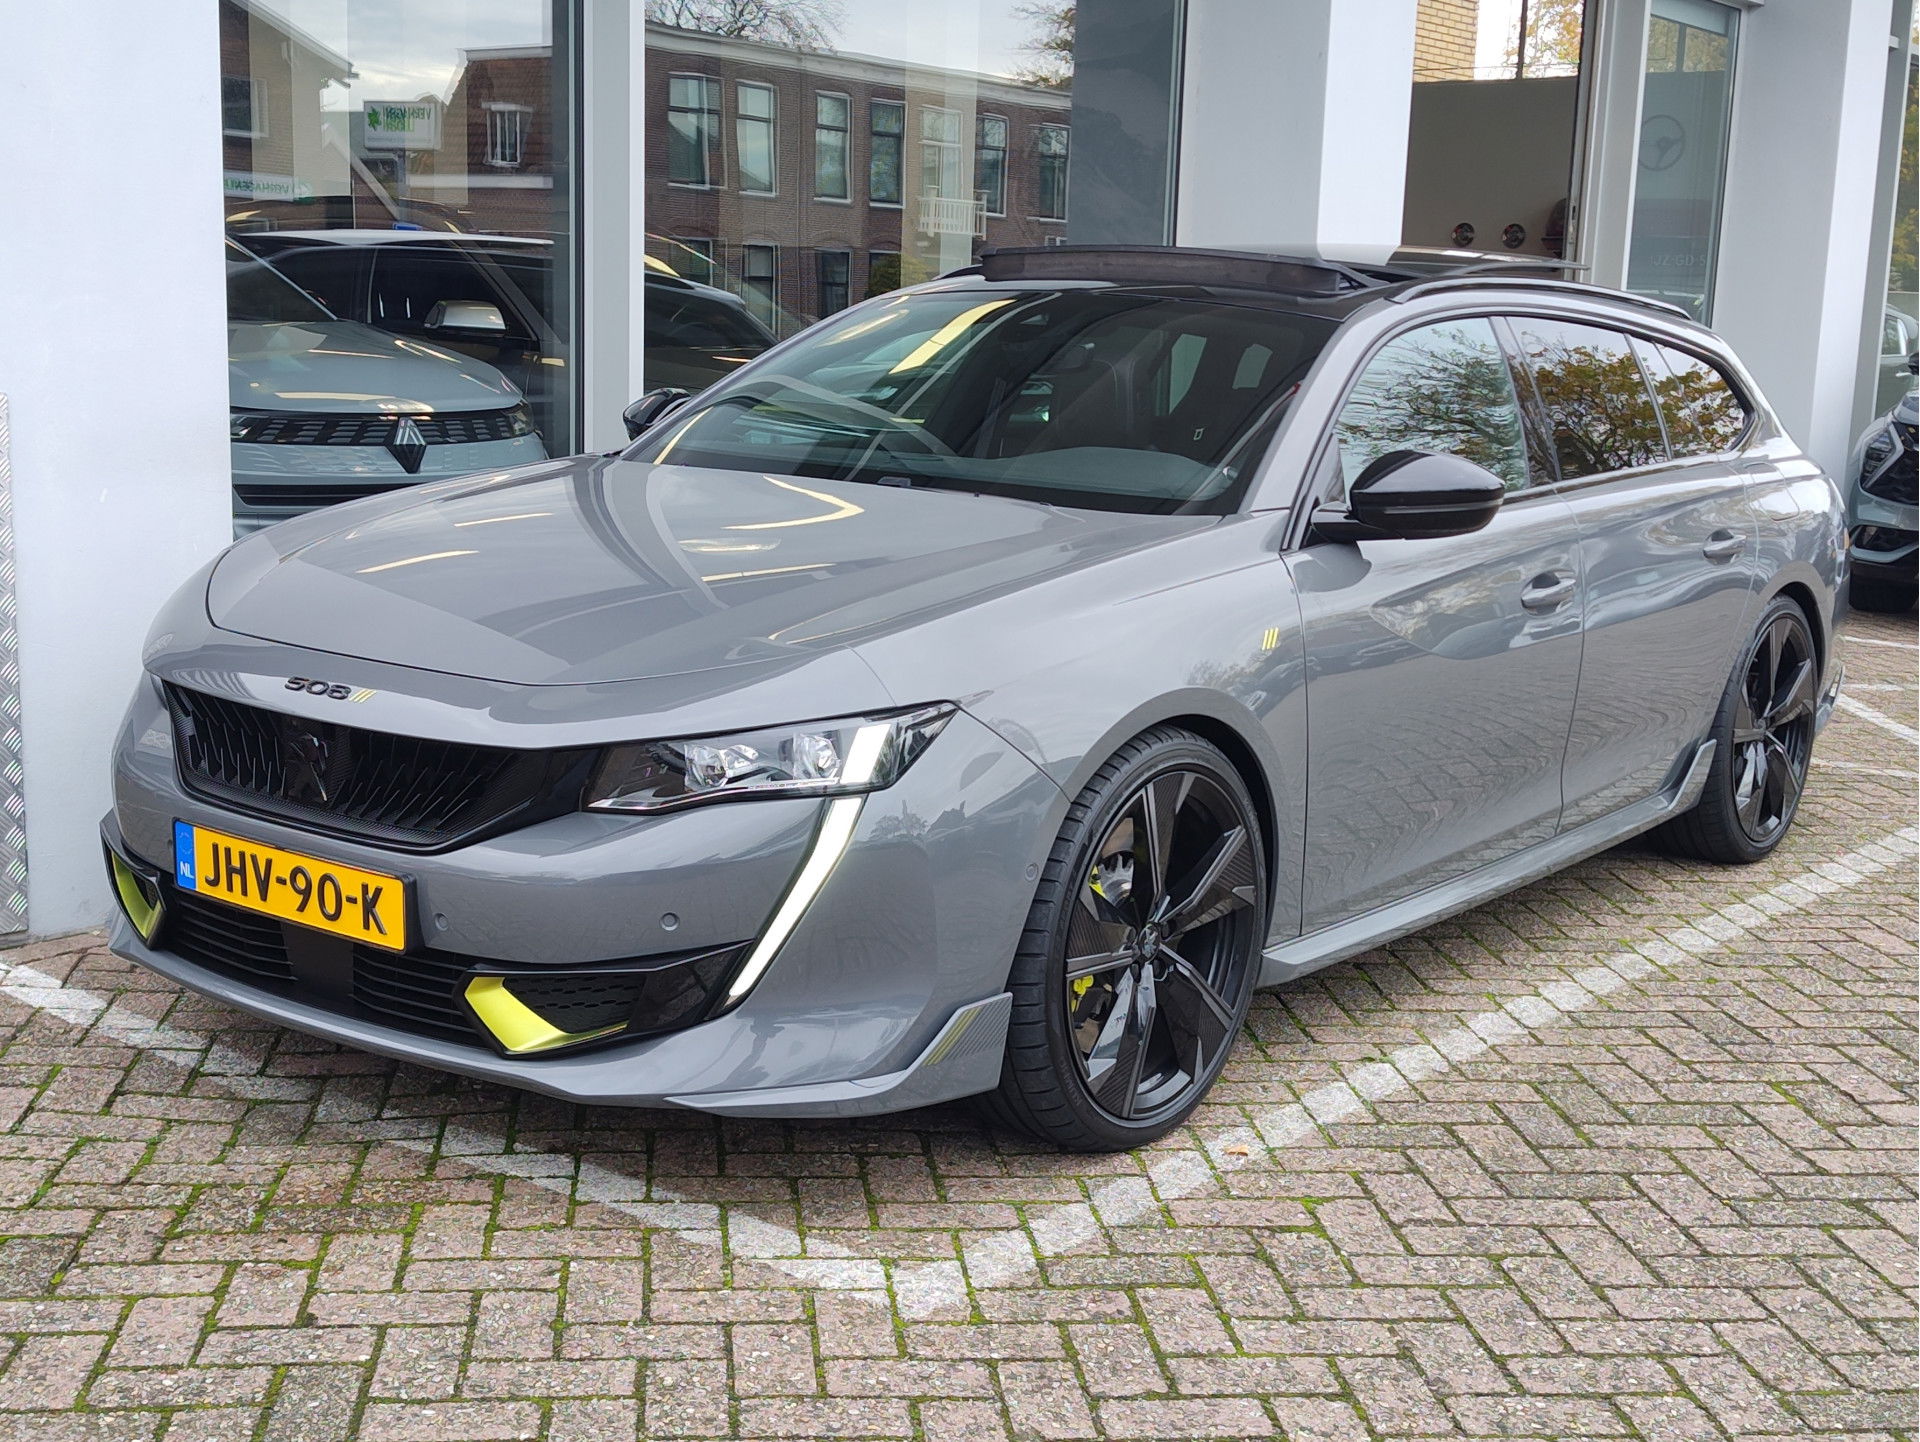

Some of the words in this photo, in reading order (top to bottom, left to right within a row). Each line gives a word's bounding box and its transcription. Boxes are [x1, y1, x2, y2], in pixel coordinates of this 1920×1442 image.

[284, 676, 351, 700] 508
[180, 861, 195, 879] NL
[205, 842, 387, 935] JHV-90-K
